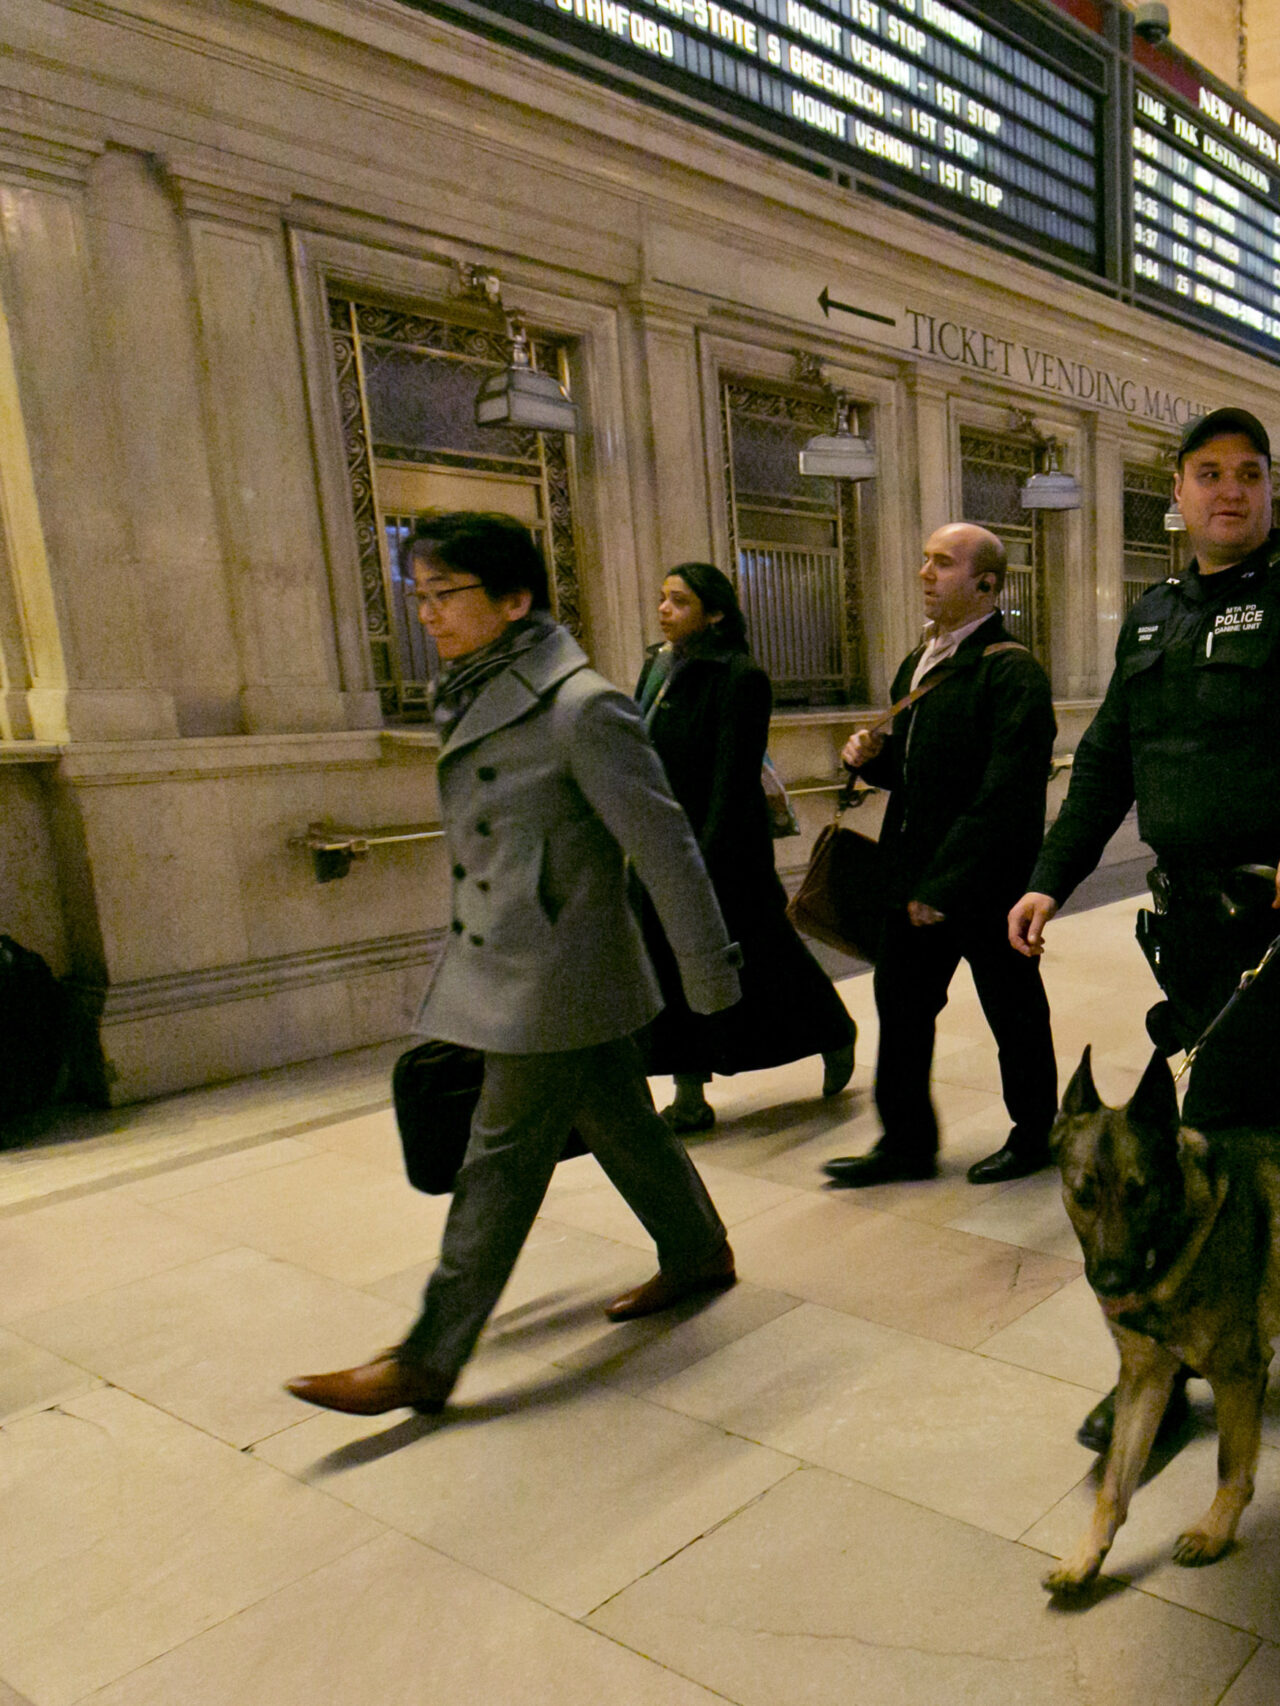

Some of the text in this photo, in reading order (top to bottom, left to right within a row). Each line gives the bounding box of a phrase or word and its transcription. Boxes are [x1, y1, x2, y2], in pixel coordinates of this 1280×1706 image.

[850, 0, 926, 55] 1ST STOP
[922, 0, 982, 55] DANBURY
[656, 0, 758, 54] N-STATE
[767, 33, 782, 66] S
[789, 45, 884, 117] GREENWICH
[910, 107, 937, 141] 1ST
[943, 125, 979, 161] STOP
[787, 0, 842, 51] MOUNT
[850, 34, 910, 90] VERNON
[935, 81, 962, 115] 1ST
[967, 99, 1001, 136] STOP
[791, 90, 846, 138] MOUNT
[854, 119, 914, 170] VERNON
[937, 160, 964, 194] 1ST
[969, 175, 1004, 210] STOP
[1136, 89, 1167, 126] TIME
[1173, 113, 1199, 147] TRK
[1202, 133, 1270, 194] DESTINATION
[1199, 86, 1232, 128] NEW
[1233, 111, 1277, 161] HAVEN
[904, 306, 1213, 428] TICKET VENDING MACH
[1214, 610, 1264, 627] POLICE
[1214, 622, 1261, 635] CANINE UNIT
[1225, 606, 1242, 614] MTA
